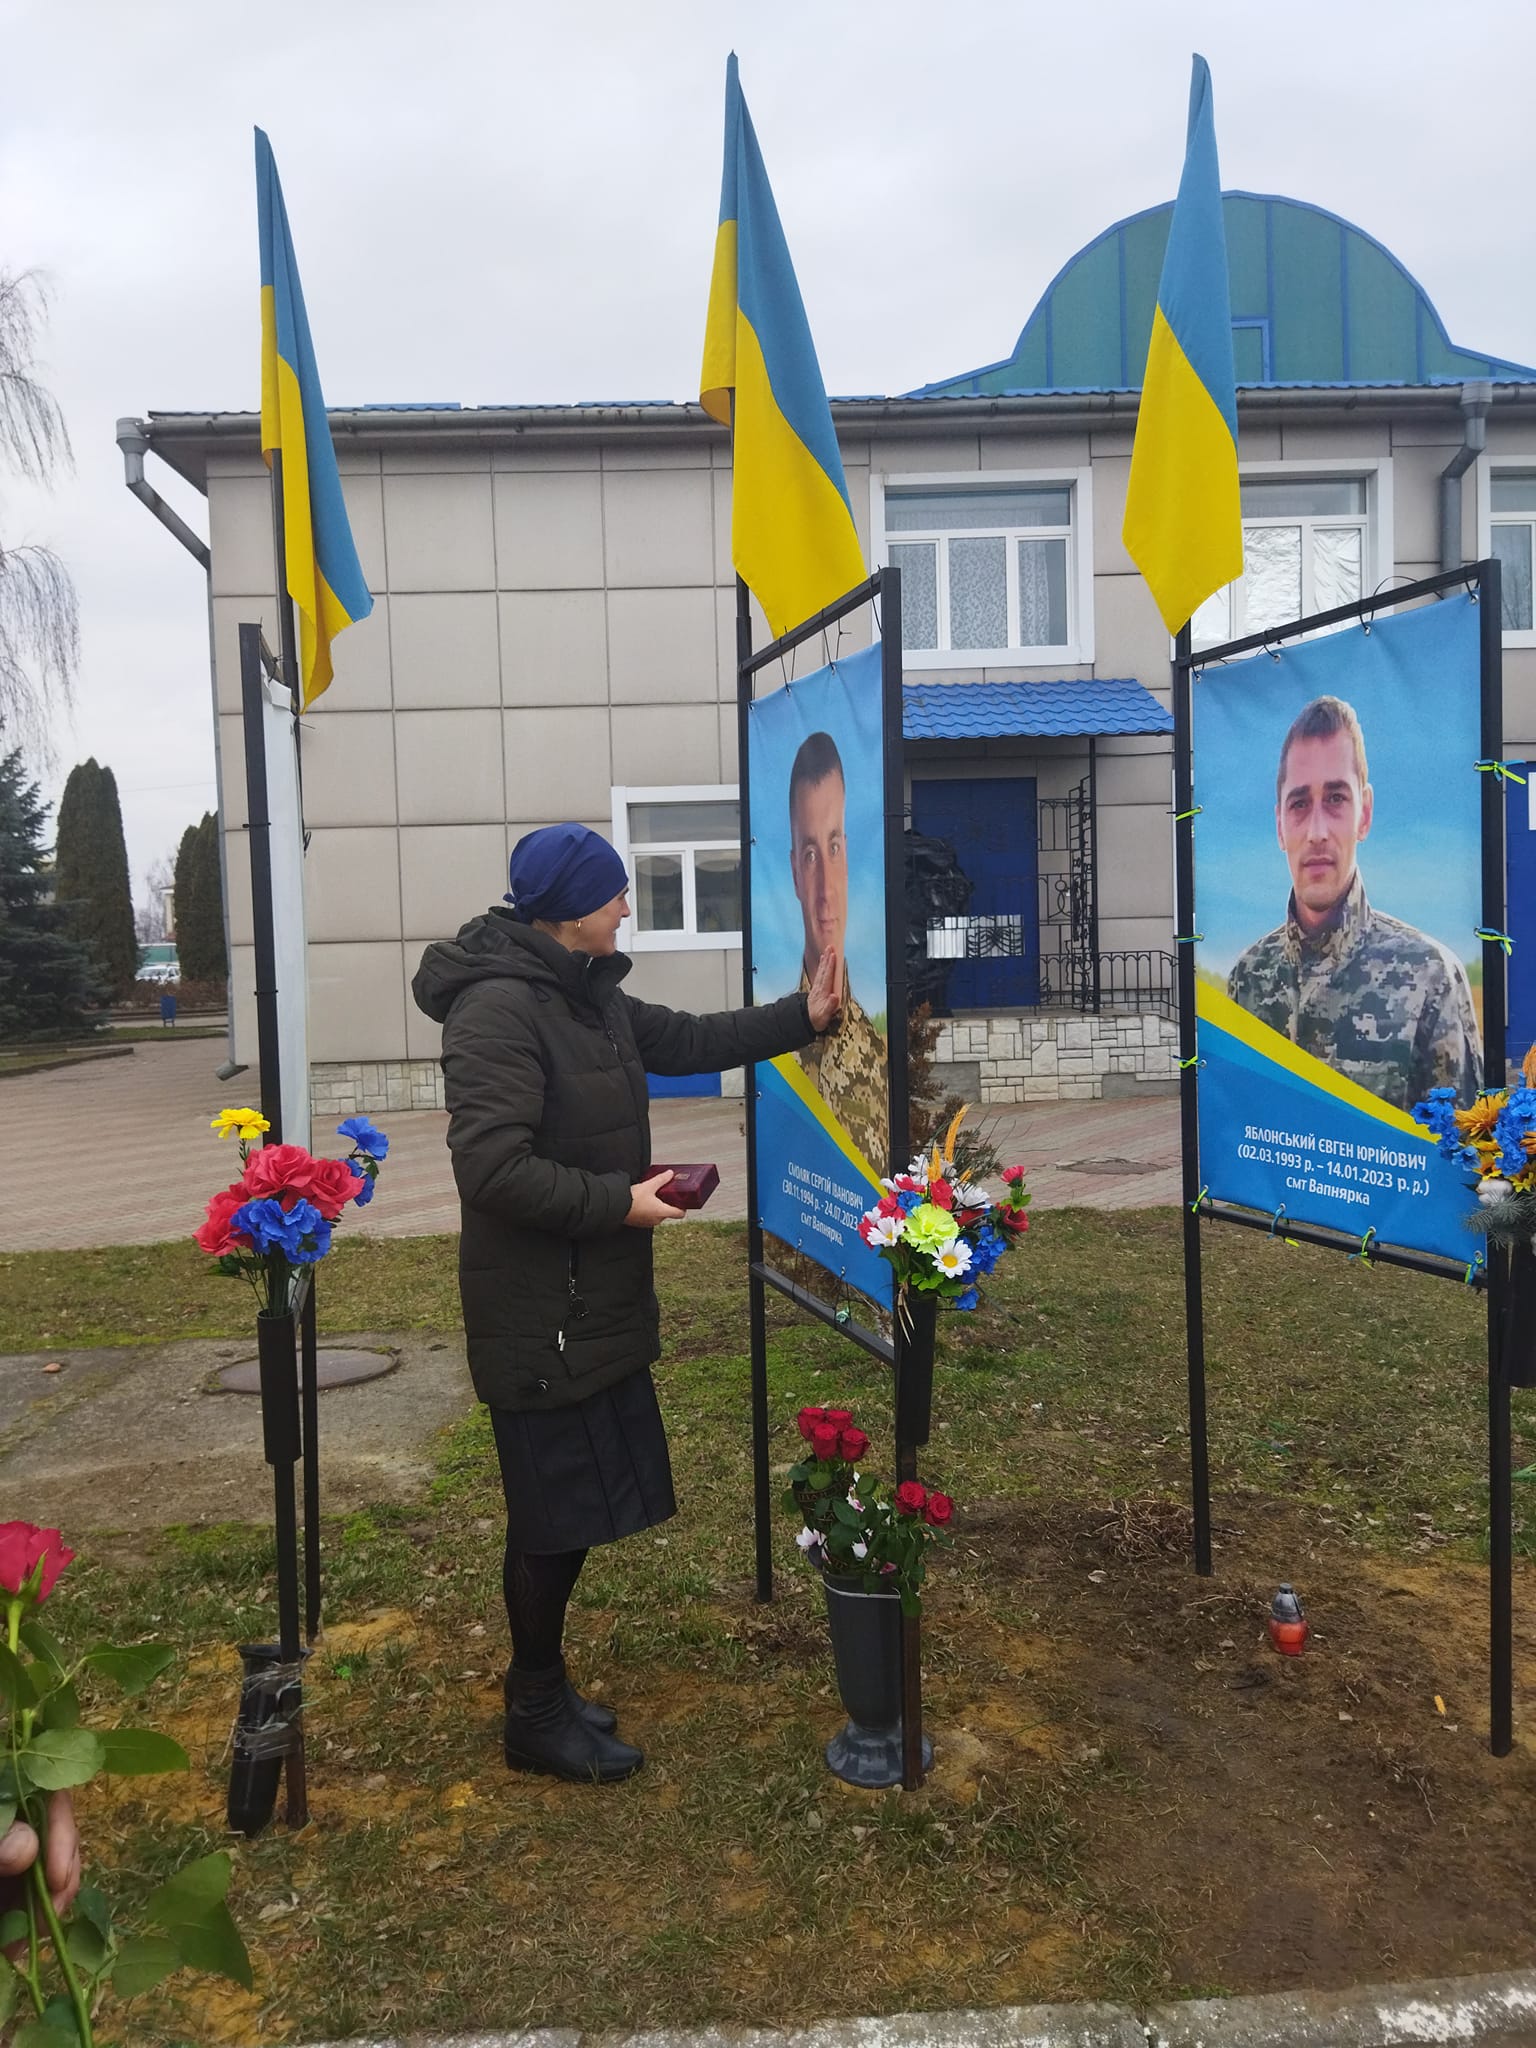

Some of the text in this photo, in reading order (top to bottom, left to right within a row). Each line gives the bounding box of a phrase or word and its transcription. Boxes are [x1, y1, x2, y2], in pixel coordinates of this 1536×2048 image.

[1244, 1125, 1427, 1171] ЯБЛОНСЬКИЙ ЄВГЕН ЮРІЙОВИЧ
[1238, 1144, 1302, 1169] (02.03.1993
[1304, 1160, 1315, 1173] р.
[1326, 1161, 1393, 1189] 14.01.2023
[1397, 1177, 1410, 1192] р.
[1412, 1179, 1430, 1196] р.)
[811, 1172, 831, 1195] СЕРГІЙ
[832, 1182, 863, 1211] ІВАНОВИЧ
[1286, 1175, 1370, 1206] смт Вапнярка
[800, 1212, 812, 1225] смт
[824, 1200, 858, 1231] 24.07.2023
